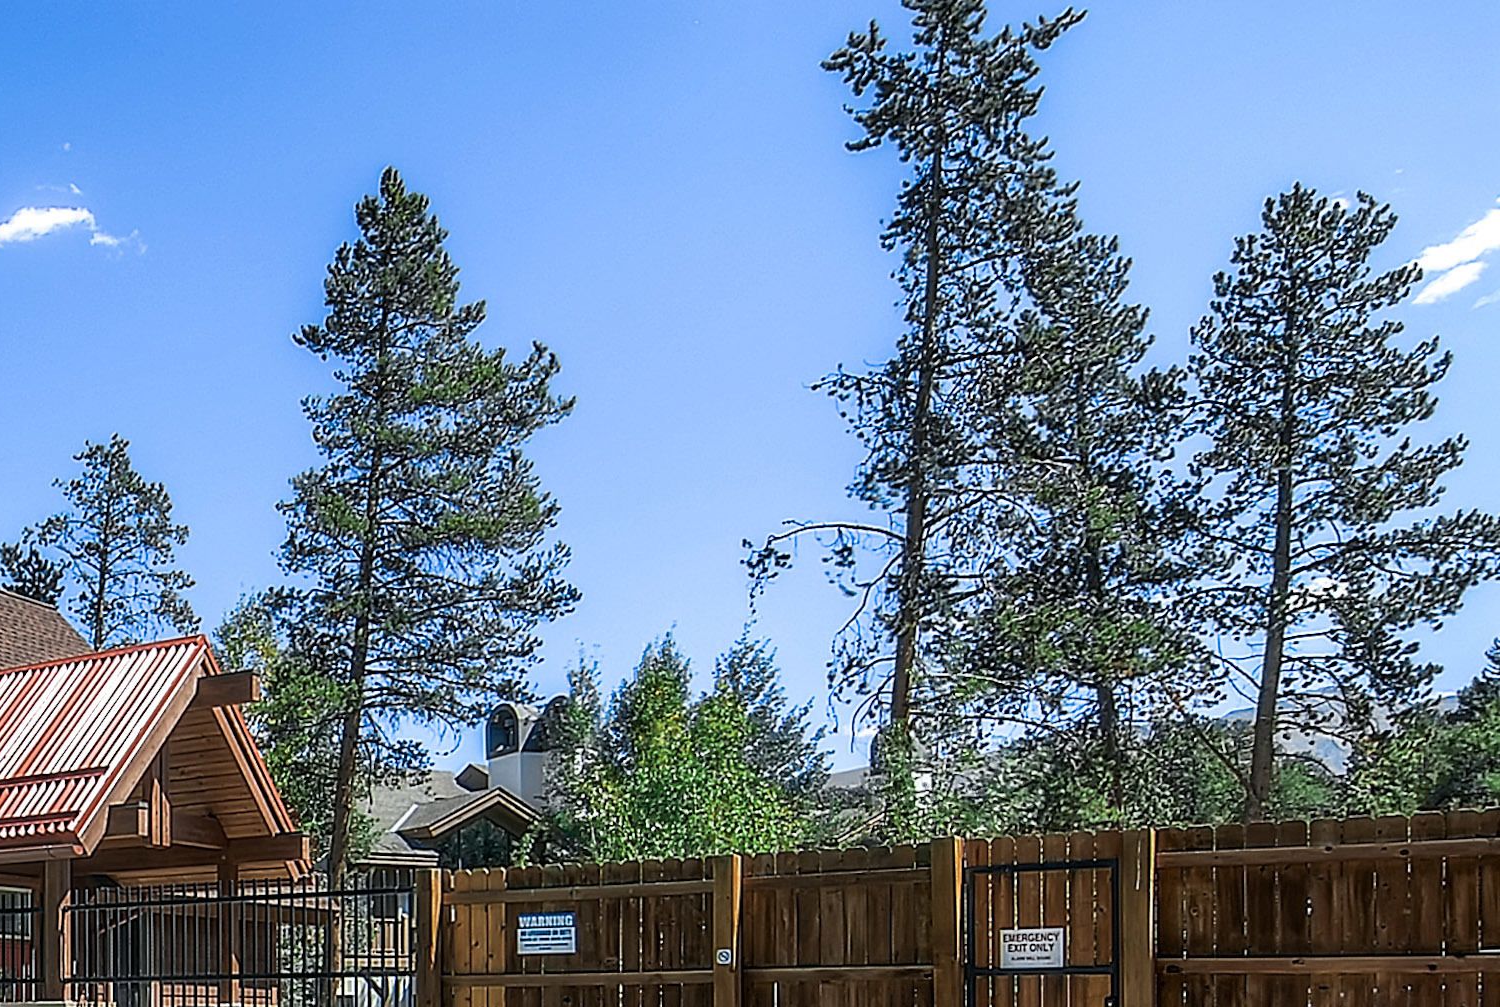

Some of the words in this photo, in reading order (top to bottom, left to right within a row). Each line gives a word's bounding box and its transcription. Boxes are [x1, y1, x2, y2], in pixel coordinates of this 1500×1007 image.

[518, 915, 573, 928] WARNING
[1003, 932, 1061, 943] EMERGENCY
[1008, 943, 1028, 953] EXIT
[1029, 943, 1055, 952] ONLY
